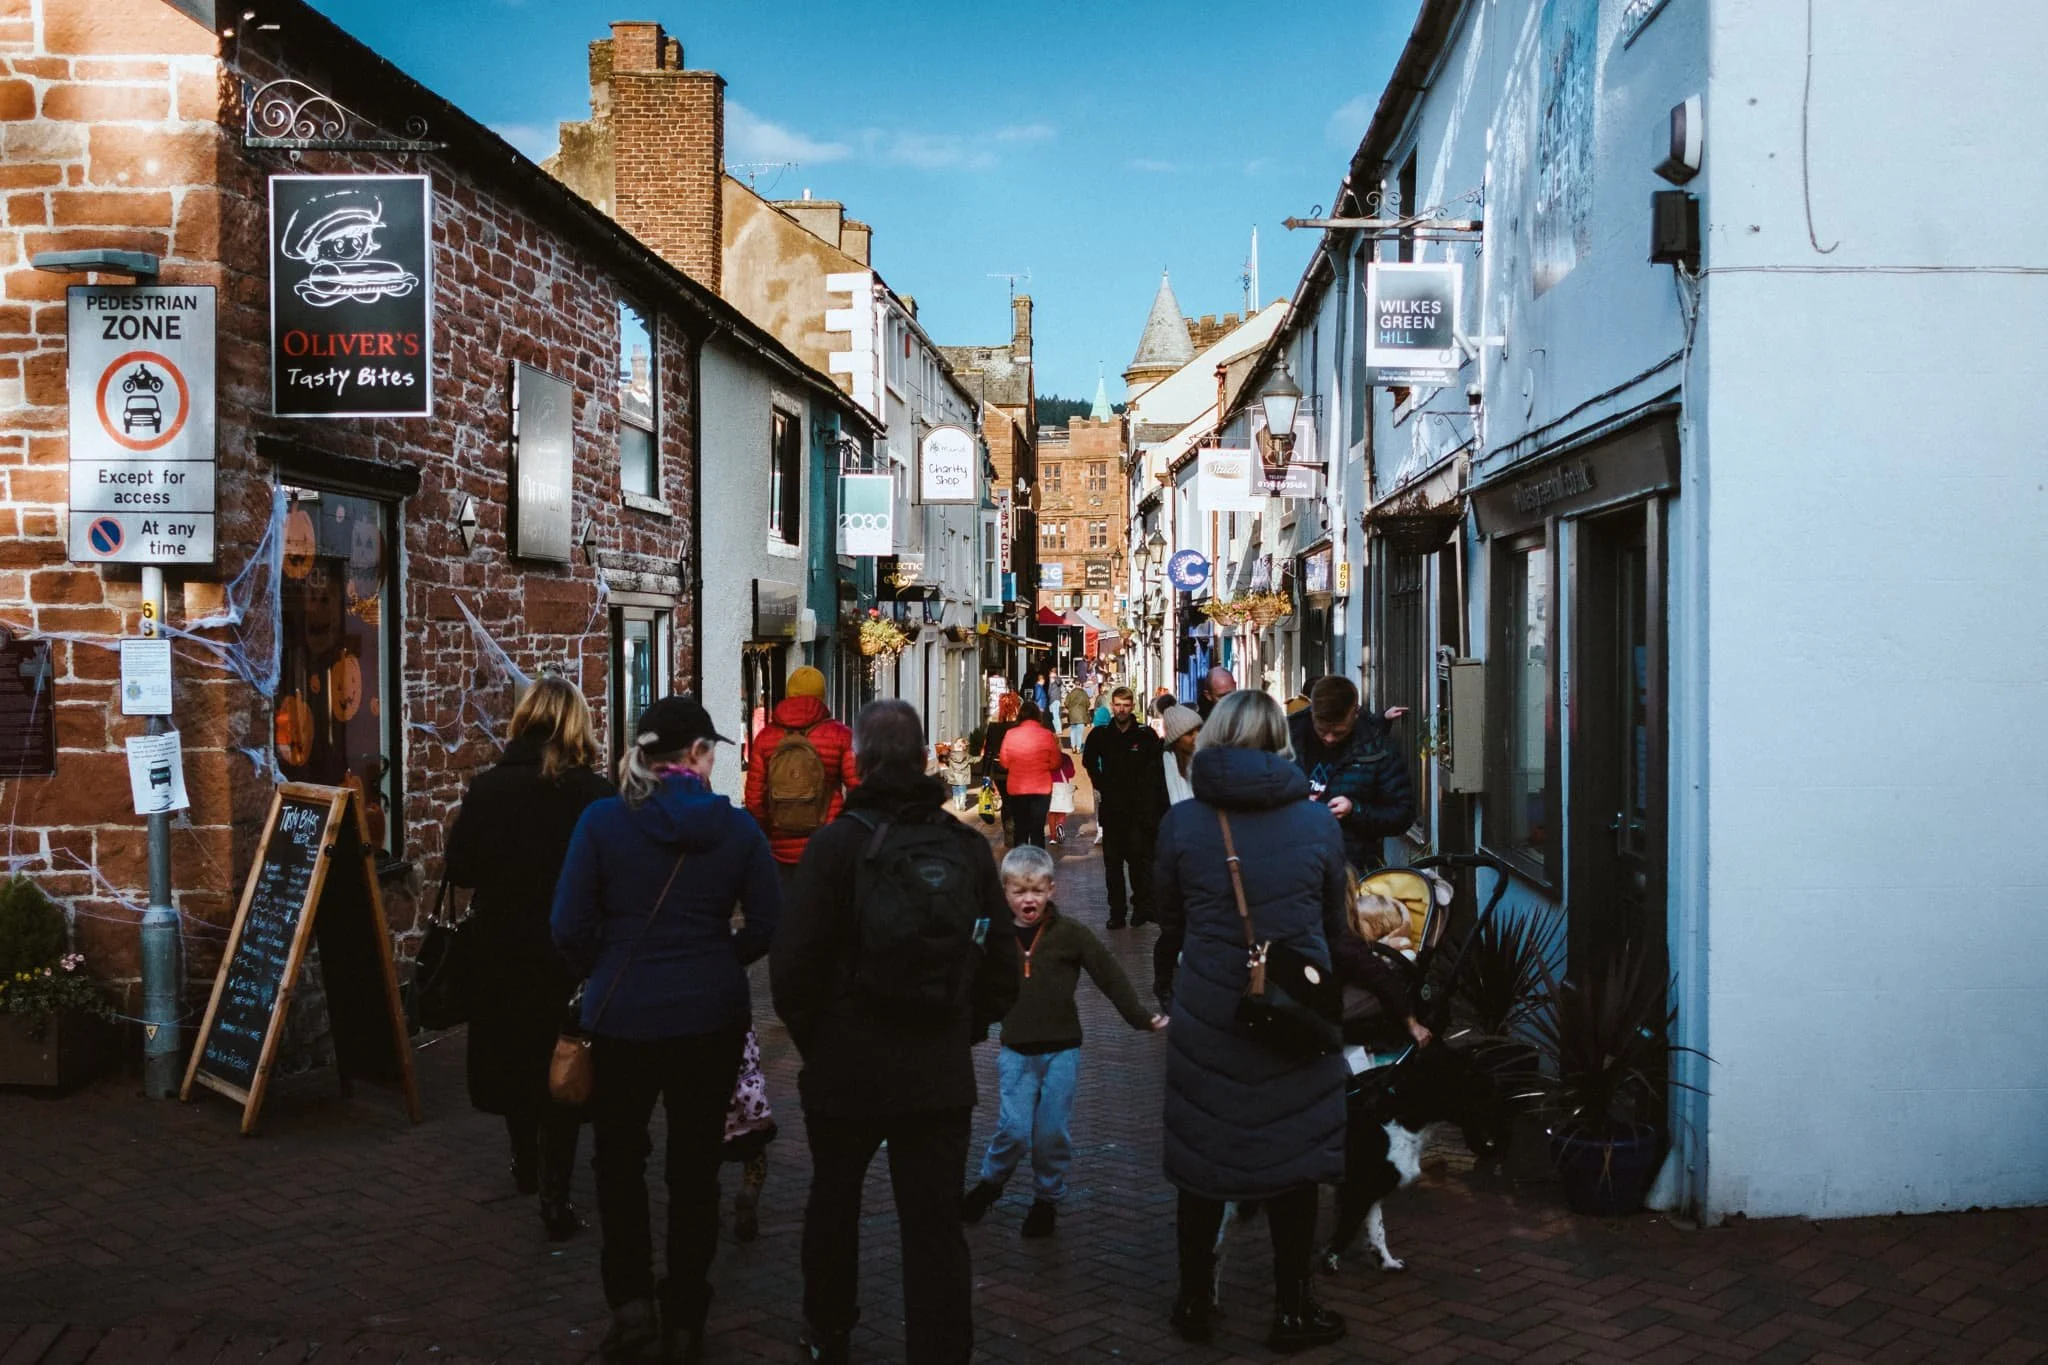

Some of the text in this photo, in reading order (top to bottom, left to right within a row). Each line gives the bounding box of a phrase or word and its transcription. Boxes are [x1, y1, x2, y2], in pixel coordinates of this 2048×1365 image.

[87, 295, 197, 310] PEDESTRIAN
[1380, 300, 1441, 314] WILKES
[102, 315, 181, 340] ZONE
[1380, 316, 1435, 329] GREEN
[284, 330, 419, 357] OLIVER'S
[1380, 332, 1414, 344] HILL
[288, 367, 415, 397] Tasty Bites
[98, 469, 185, 486] Except for
[929, 463, 967, 479] Charity
[935, 475, 960, 487] Shop
[114, 492, 171, 504] access
[141, 520, 196, 538] At any
[839, 513, 890, 530] 2030
[150, 541, 186, 555] time
[879, 561, 924, 571] ECLECTIC
